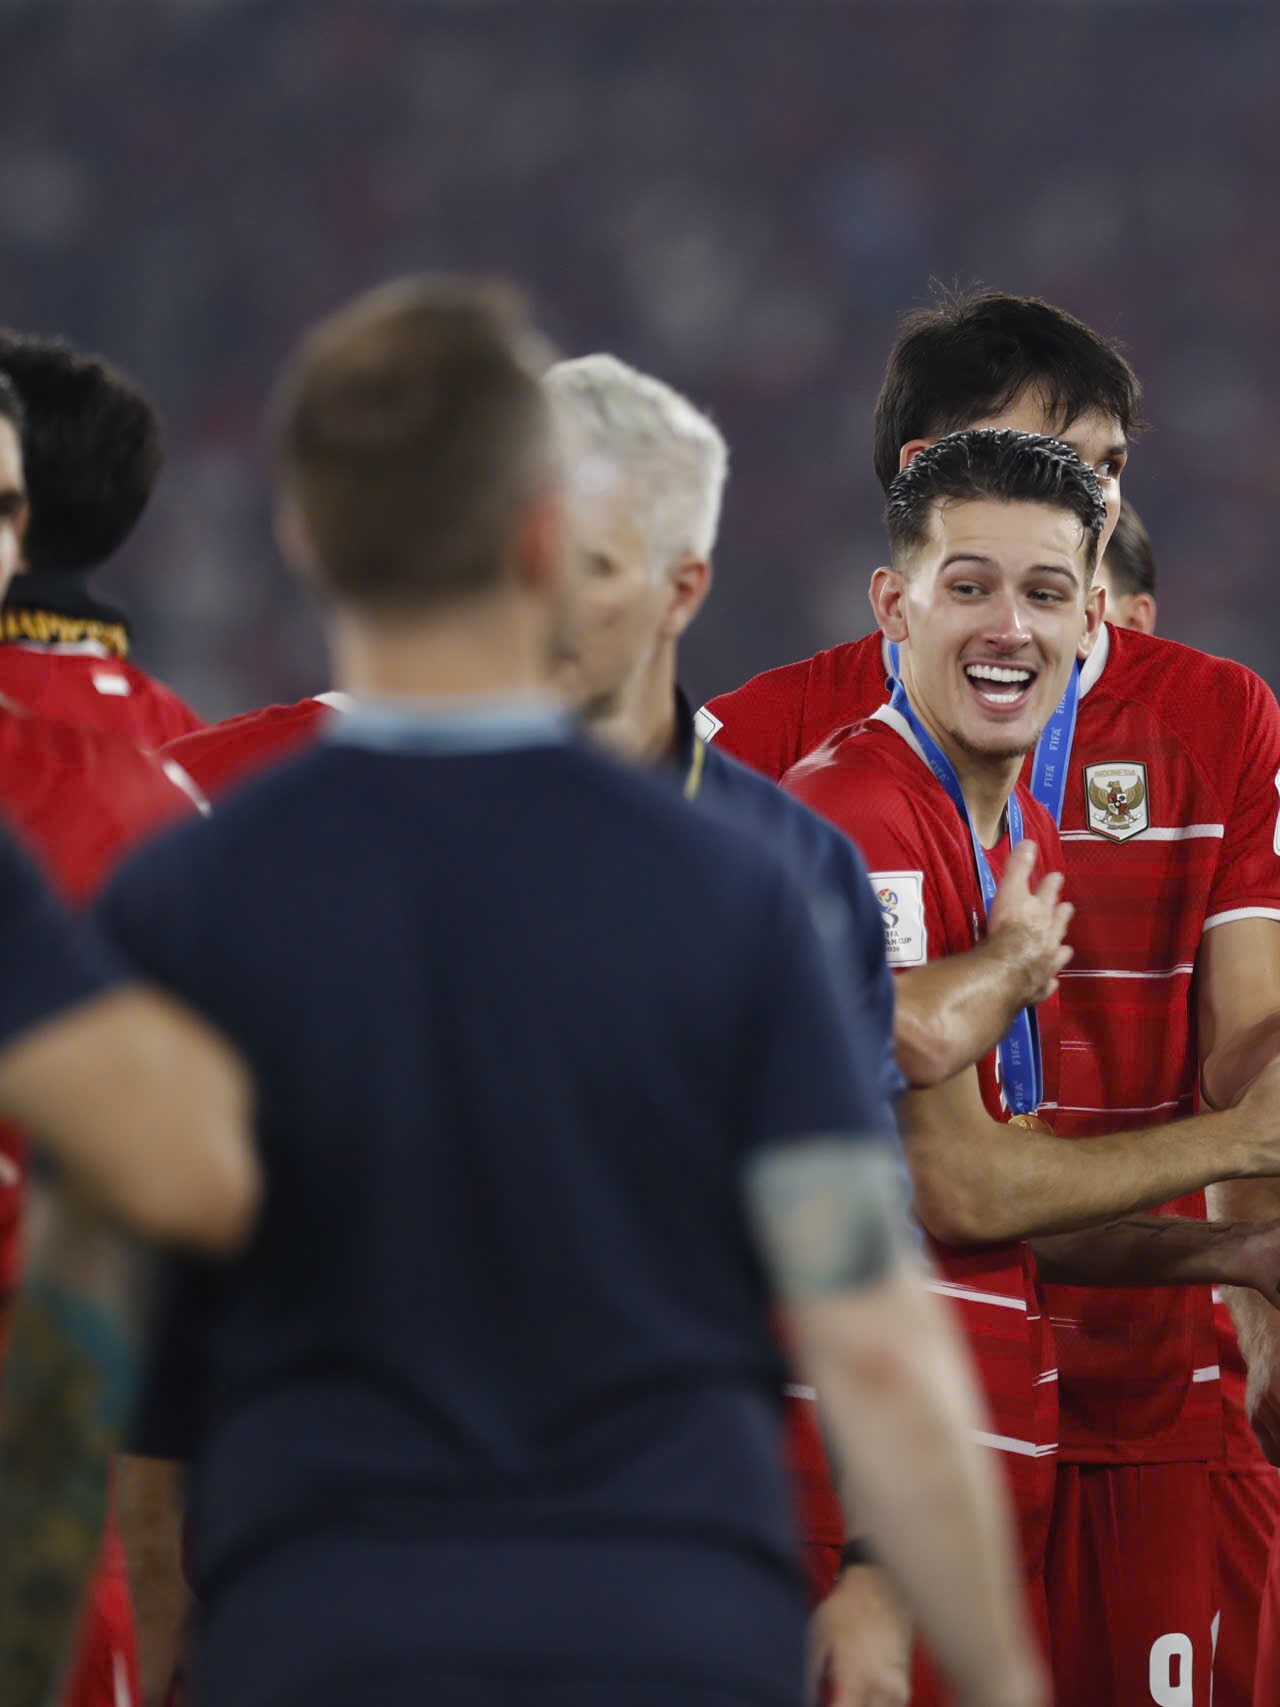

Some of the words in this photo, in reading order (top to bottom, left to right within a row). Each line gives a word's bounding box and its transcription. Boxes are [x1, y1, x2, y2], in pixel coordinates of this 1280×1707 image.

[1049, 727, 1062, 751] FIFA
[929, 758, 950, 783] FIFA
[1044, 763, 1056, 787] FIFA
[1012, 1039, 1021, 1065] FIFA
